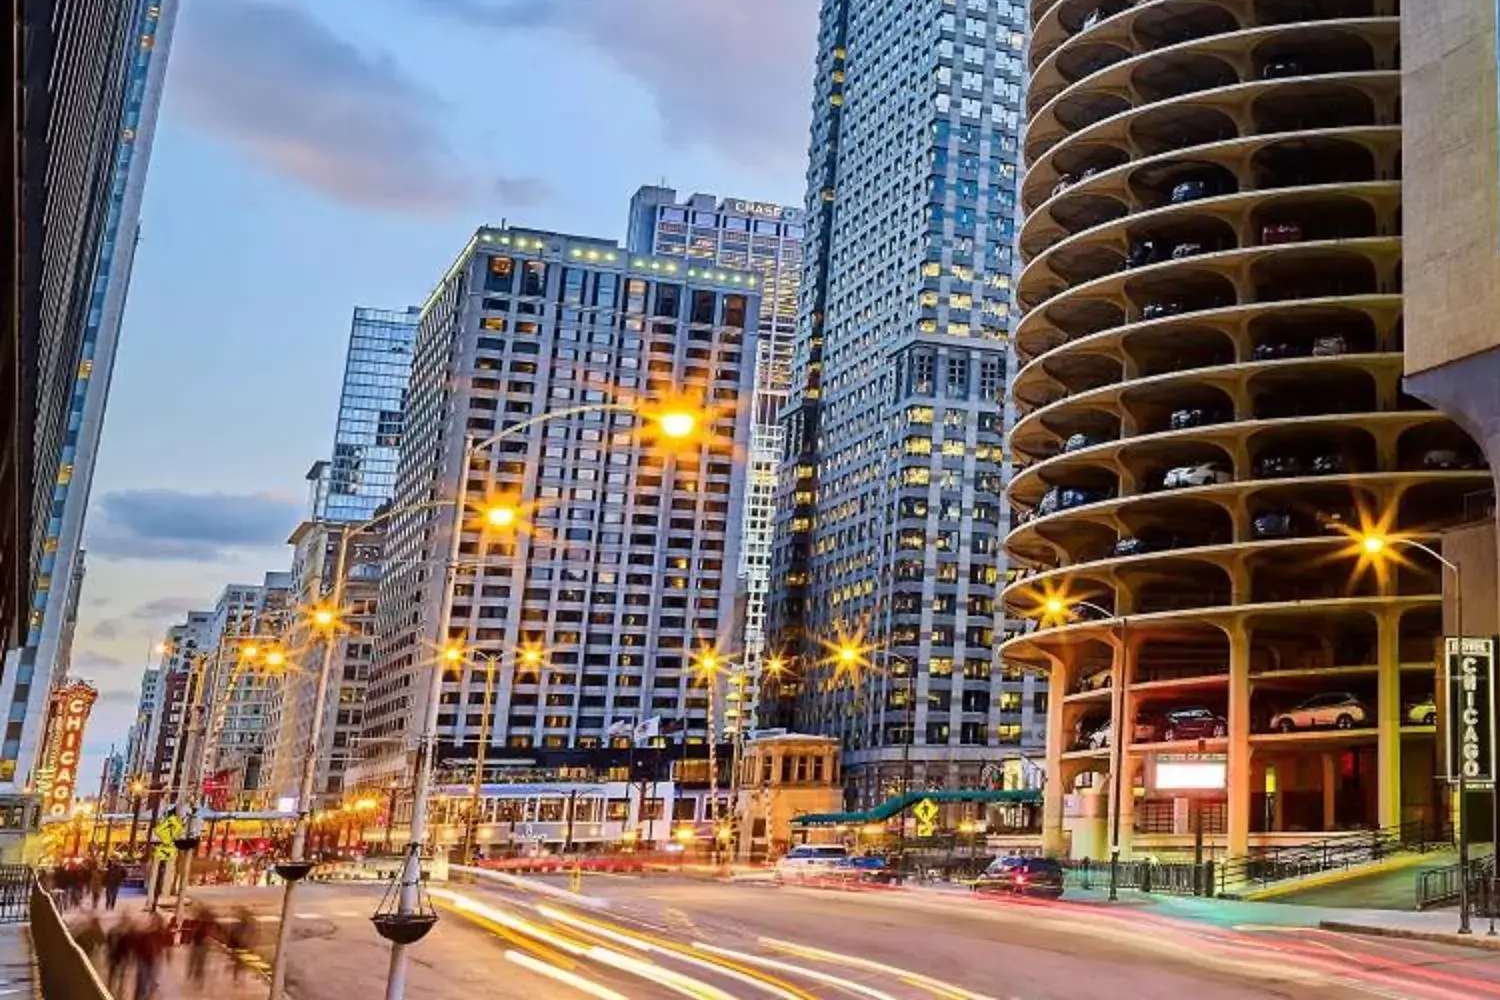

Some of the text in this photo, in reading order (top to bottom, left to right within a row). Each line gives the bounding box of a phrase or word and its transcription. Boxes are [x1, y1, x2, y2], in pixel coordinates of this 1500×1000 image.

[735, 201, 781, 217] CHASE
[50, 699, 85, 816] CHICAGO
[1462, 656, 1480, 777] CHICAGO
